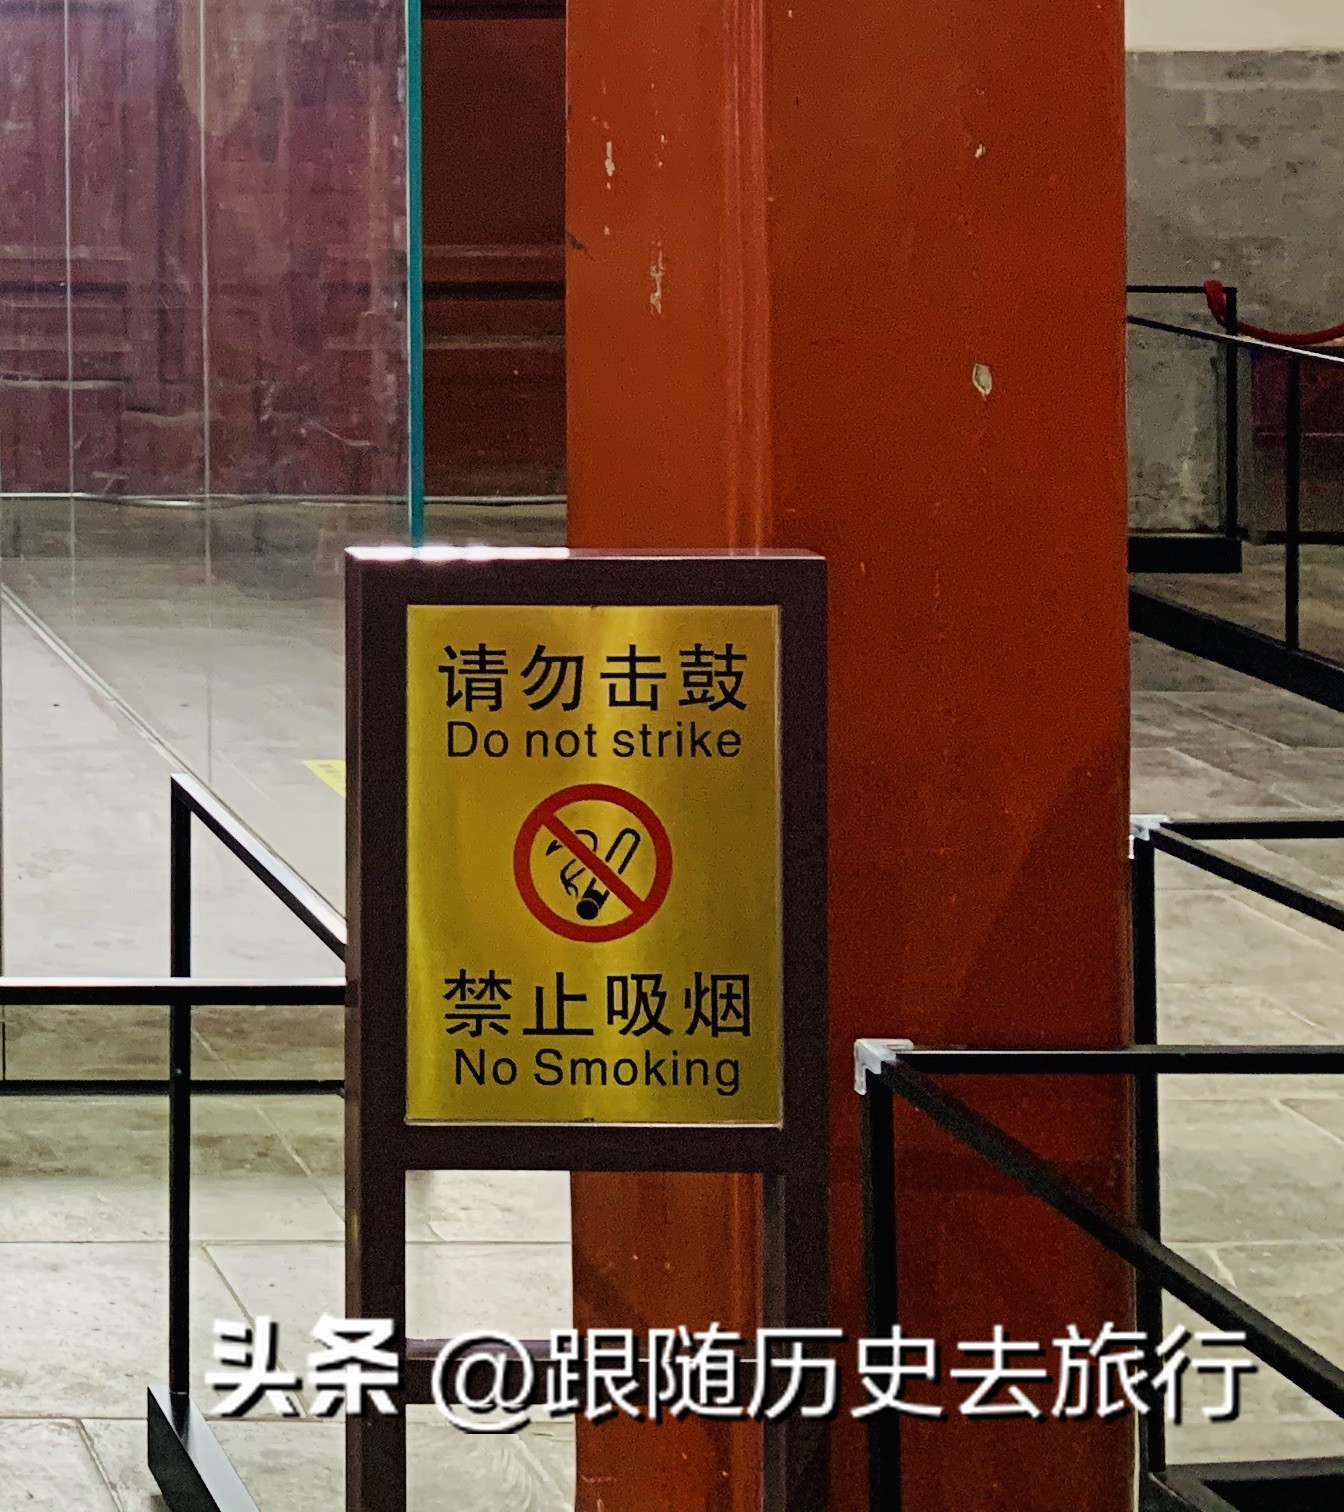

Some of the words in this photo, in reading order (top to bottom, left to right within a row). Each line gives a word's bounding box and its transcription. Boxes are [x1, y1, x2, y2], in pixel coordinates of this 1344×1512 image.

[438, 642, 748, 712] 请勿击鼓
[446, 722, 509, 758] Do
[526, 722, 598, 758] not
[613, 721, 742, 758] strike
[443, 969, 751, 1038] 禁止吸烟
[454, 1049, 517, 1086] No
[534, 1048, 740, 1096] Smoking
